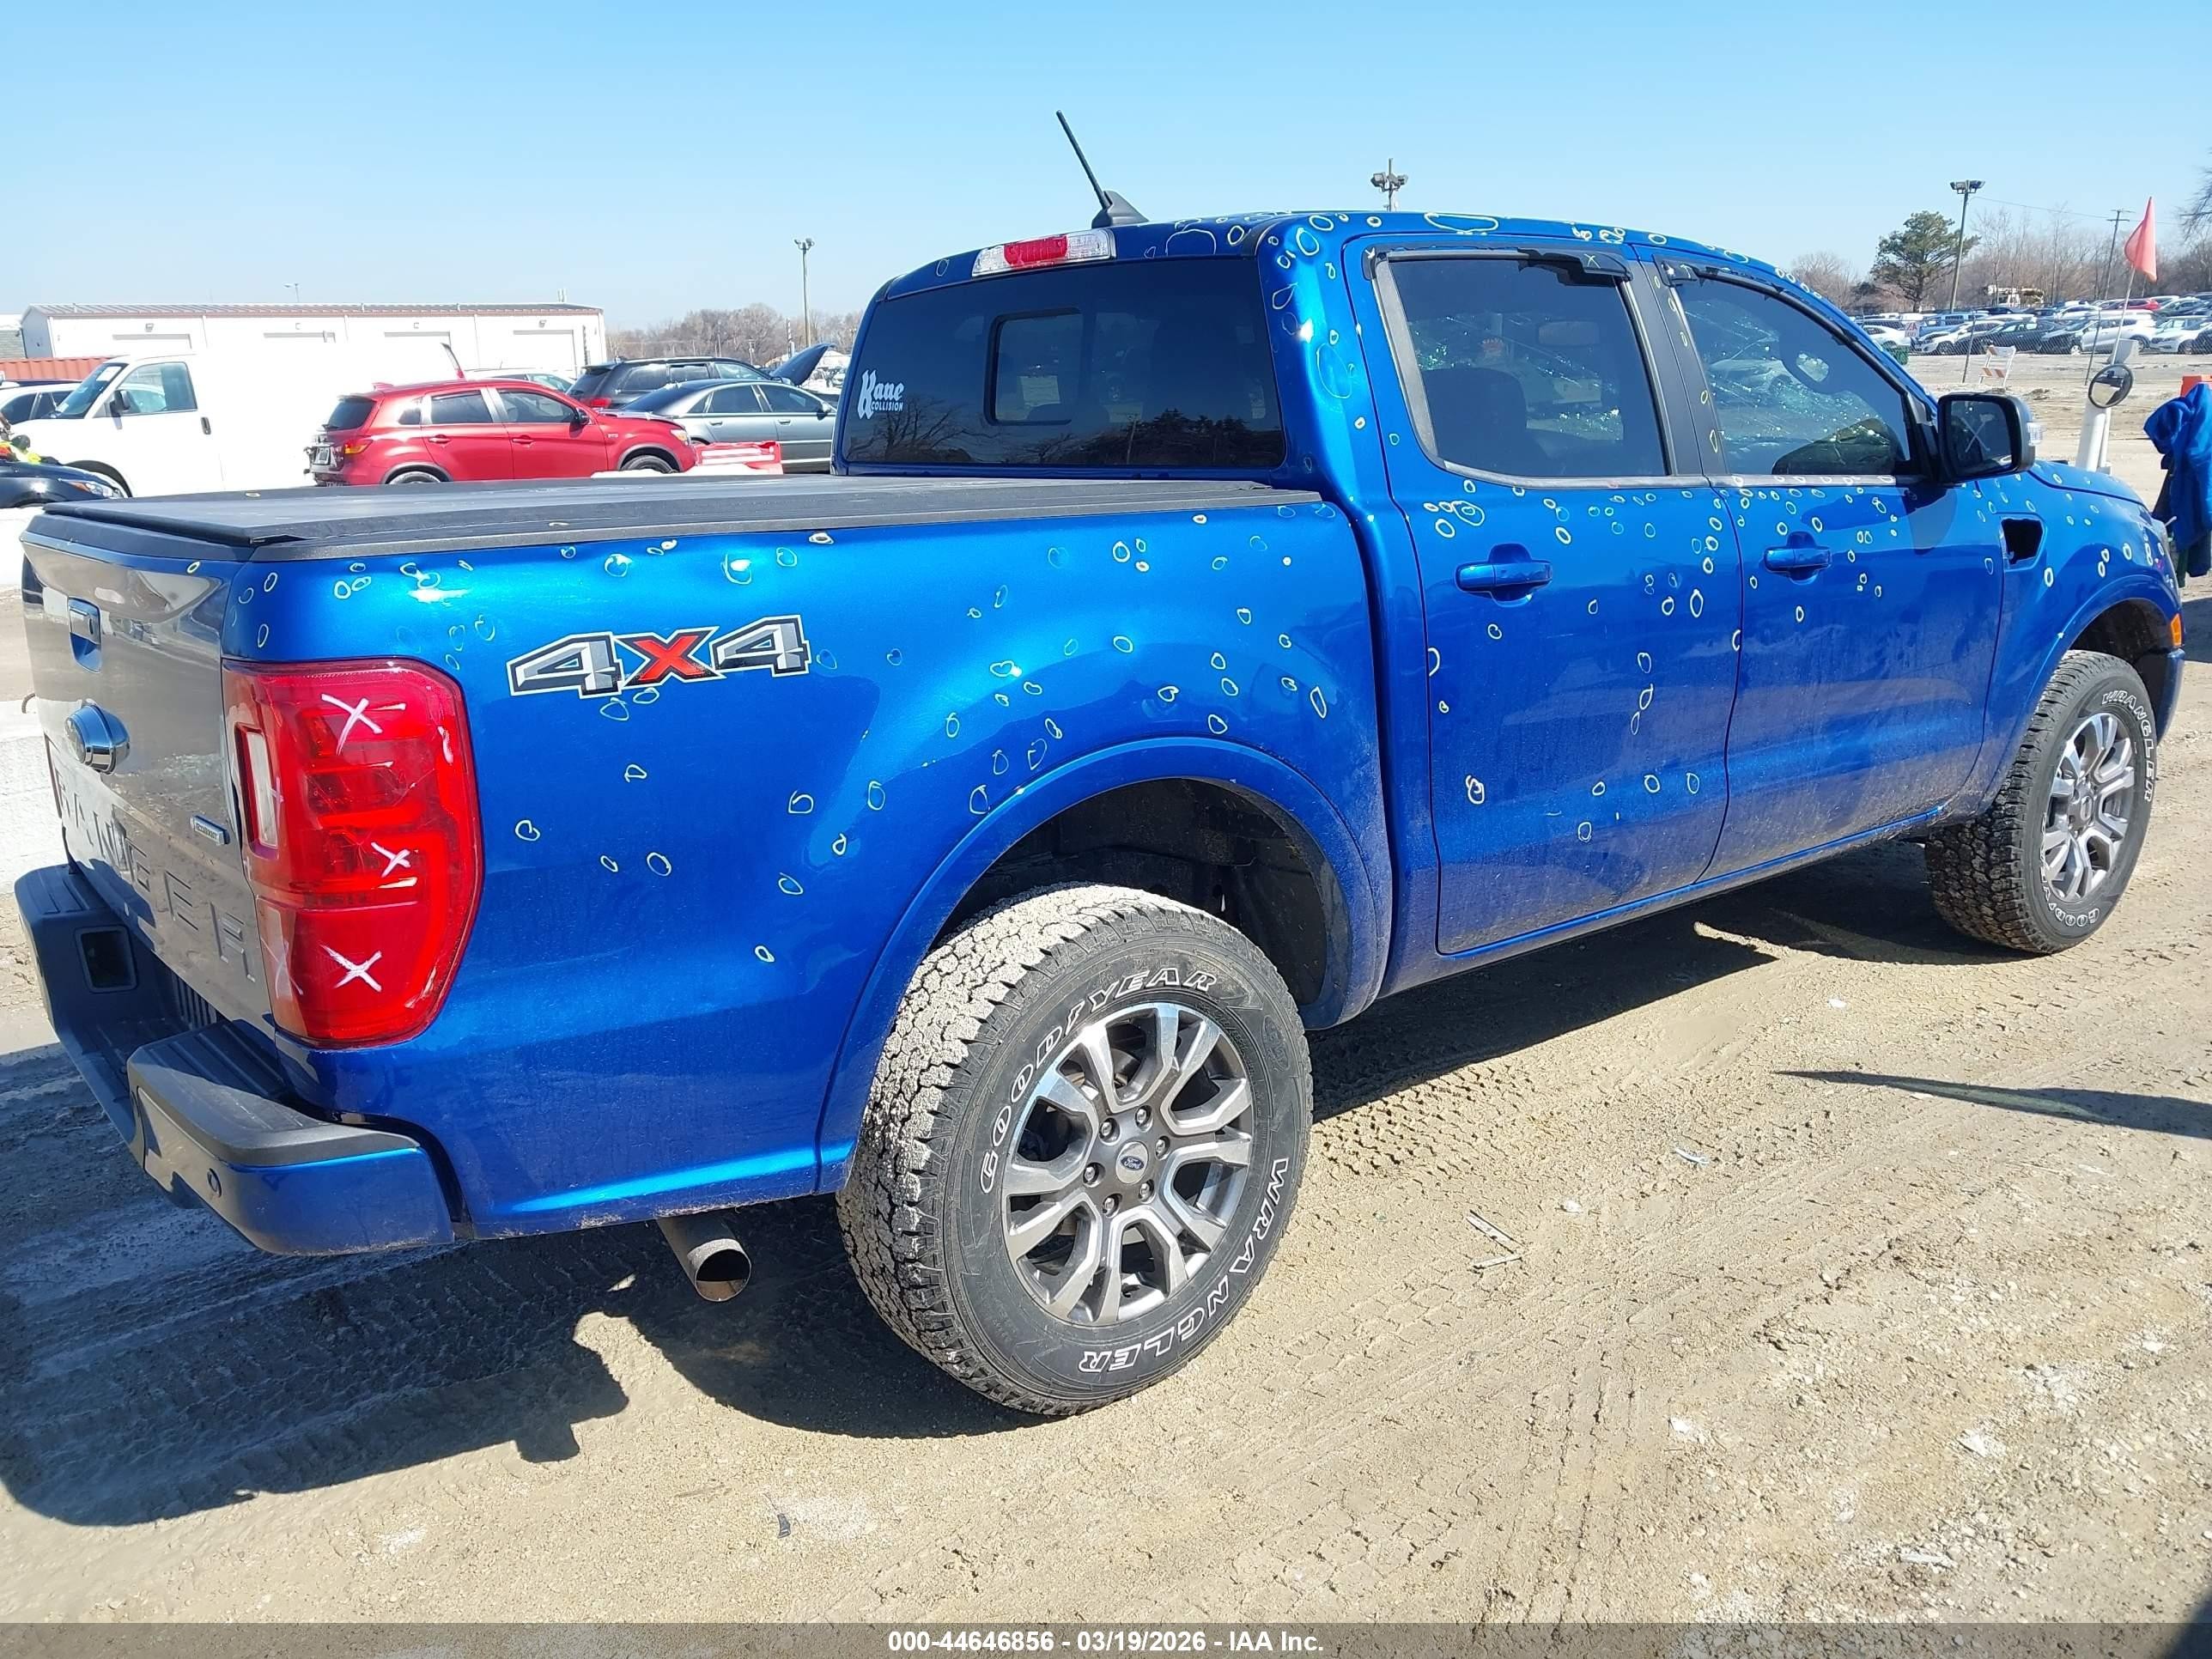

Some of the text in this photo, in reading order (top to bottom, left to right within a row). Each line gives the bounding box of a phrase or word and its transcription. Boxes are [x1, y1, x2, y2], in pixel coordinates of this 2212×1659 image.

[858, 369, 904, 419] Kane
[871, 402, 904, 411] COLLISION
[2101, 690, 2154, 802] WRANGLER
[980, 967, 1218, 1194] GOODYEAR
[1123, 1157, 1142, 1170] Ford
[1078, 1157, 1289, 1372] WRANGLER
